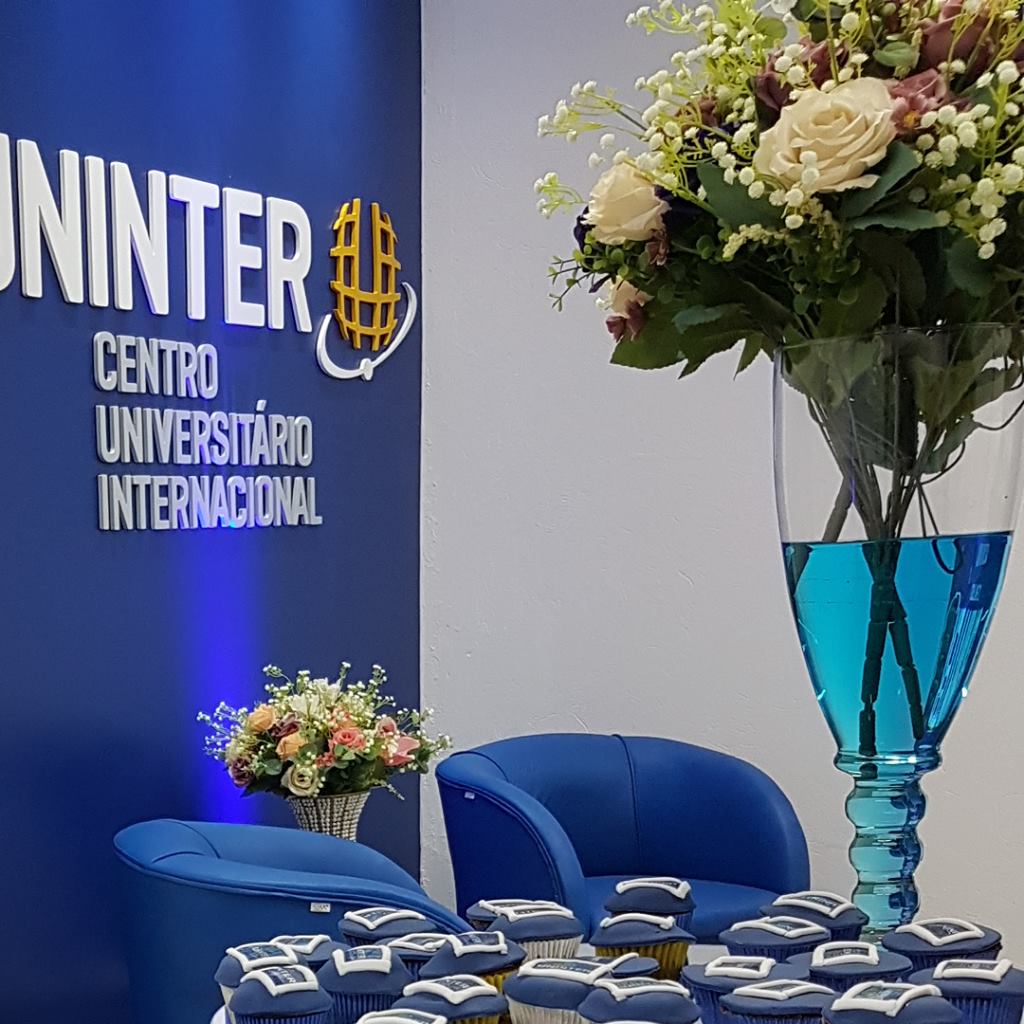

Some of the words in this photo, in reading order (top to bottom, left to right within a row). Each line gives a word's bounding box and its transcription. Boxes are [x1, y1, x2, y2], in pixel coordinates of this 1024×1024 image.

[93, 331, 219, 400] CENTRO
[95, 399, 313, 467] UNIVERSITÁRIO
[96, 474, 323, 531] INTERNACIONAL
